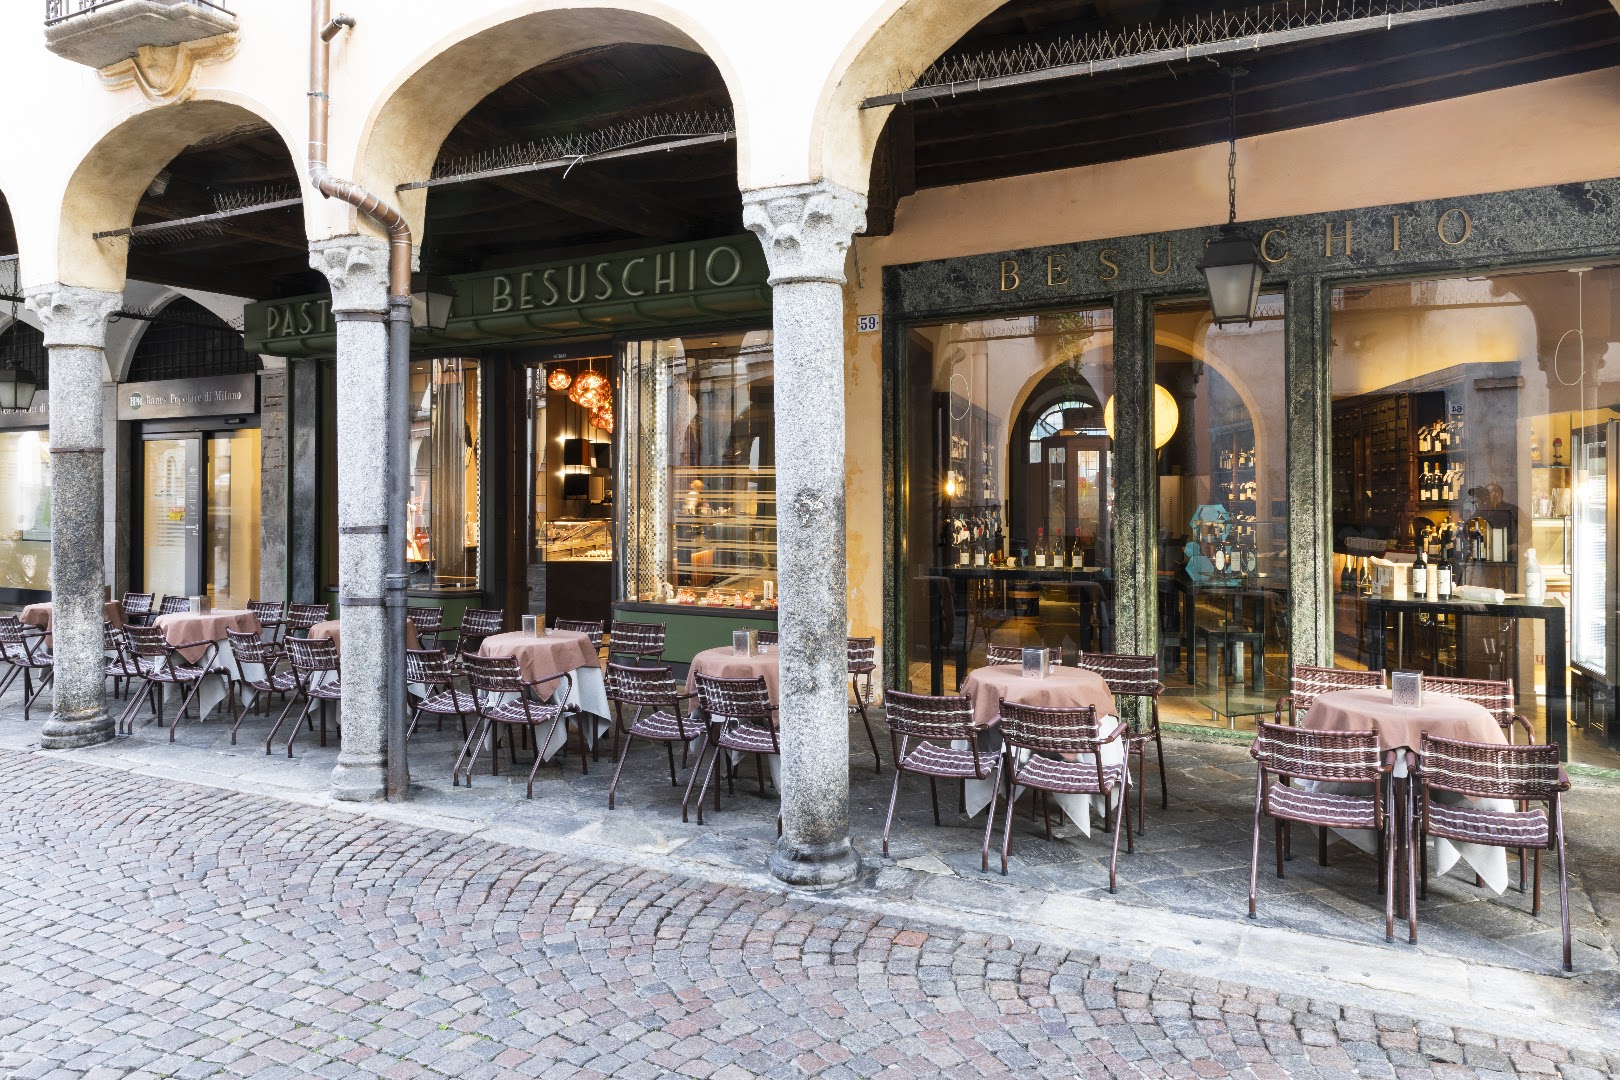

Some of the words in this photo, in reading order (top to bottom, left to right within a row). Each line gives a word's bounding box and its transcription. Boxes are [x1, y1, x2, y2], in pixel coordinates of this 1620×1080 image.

[1000, 207, 1473, 292] BESUCHIO
[267, 300, 330, 338] PAST
[492, 246, 743, 313] BESUSCHIO
[860, 316, 876, 330] 59
[170, 393, 202, 406] Popolare
[204, 391, 212, 401] di
[214, 390, 242, 401] Milano
